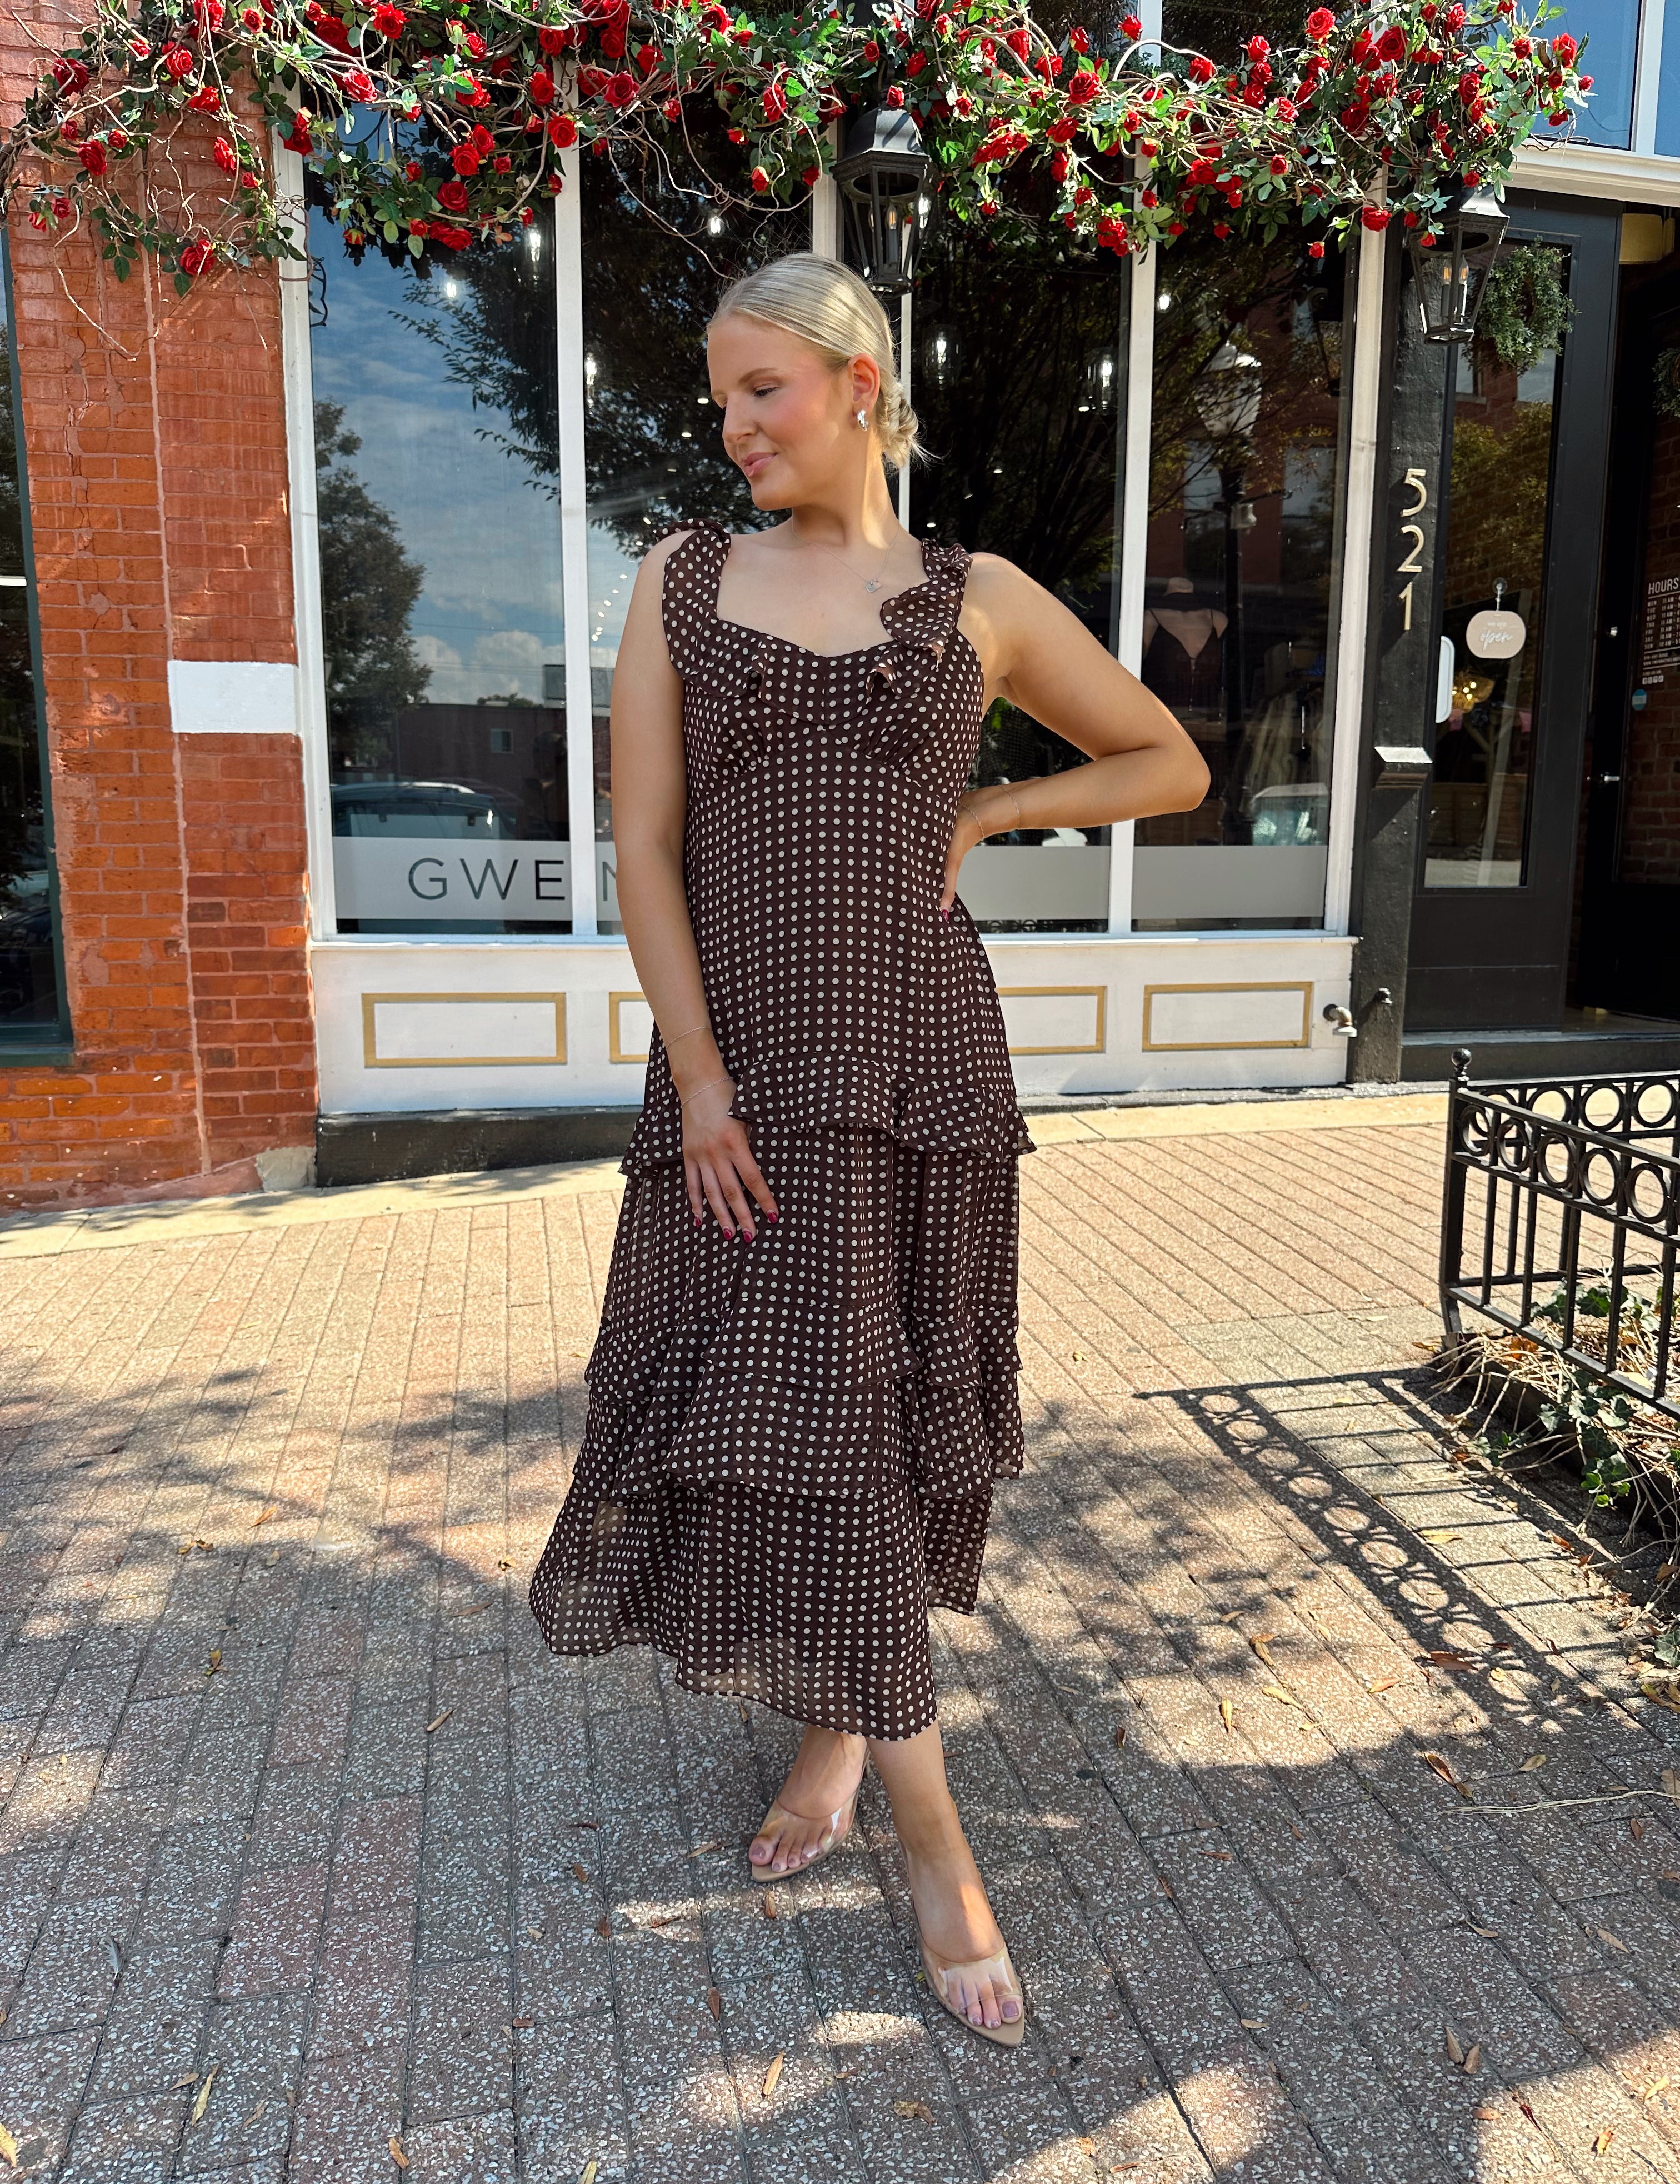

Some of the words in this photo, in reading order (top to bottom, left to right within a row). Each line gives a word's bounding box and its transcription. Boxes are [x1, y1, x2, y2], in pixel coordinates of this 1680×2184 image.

[1397, 468, 1427, 631] 521
[1648, 577, 1679, 594] HOURS
[1480, 629, 1513, 651] open
